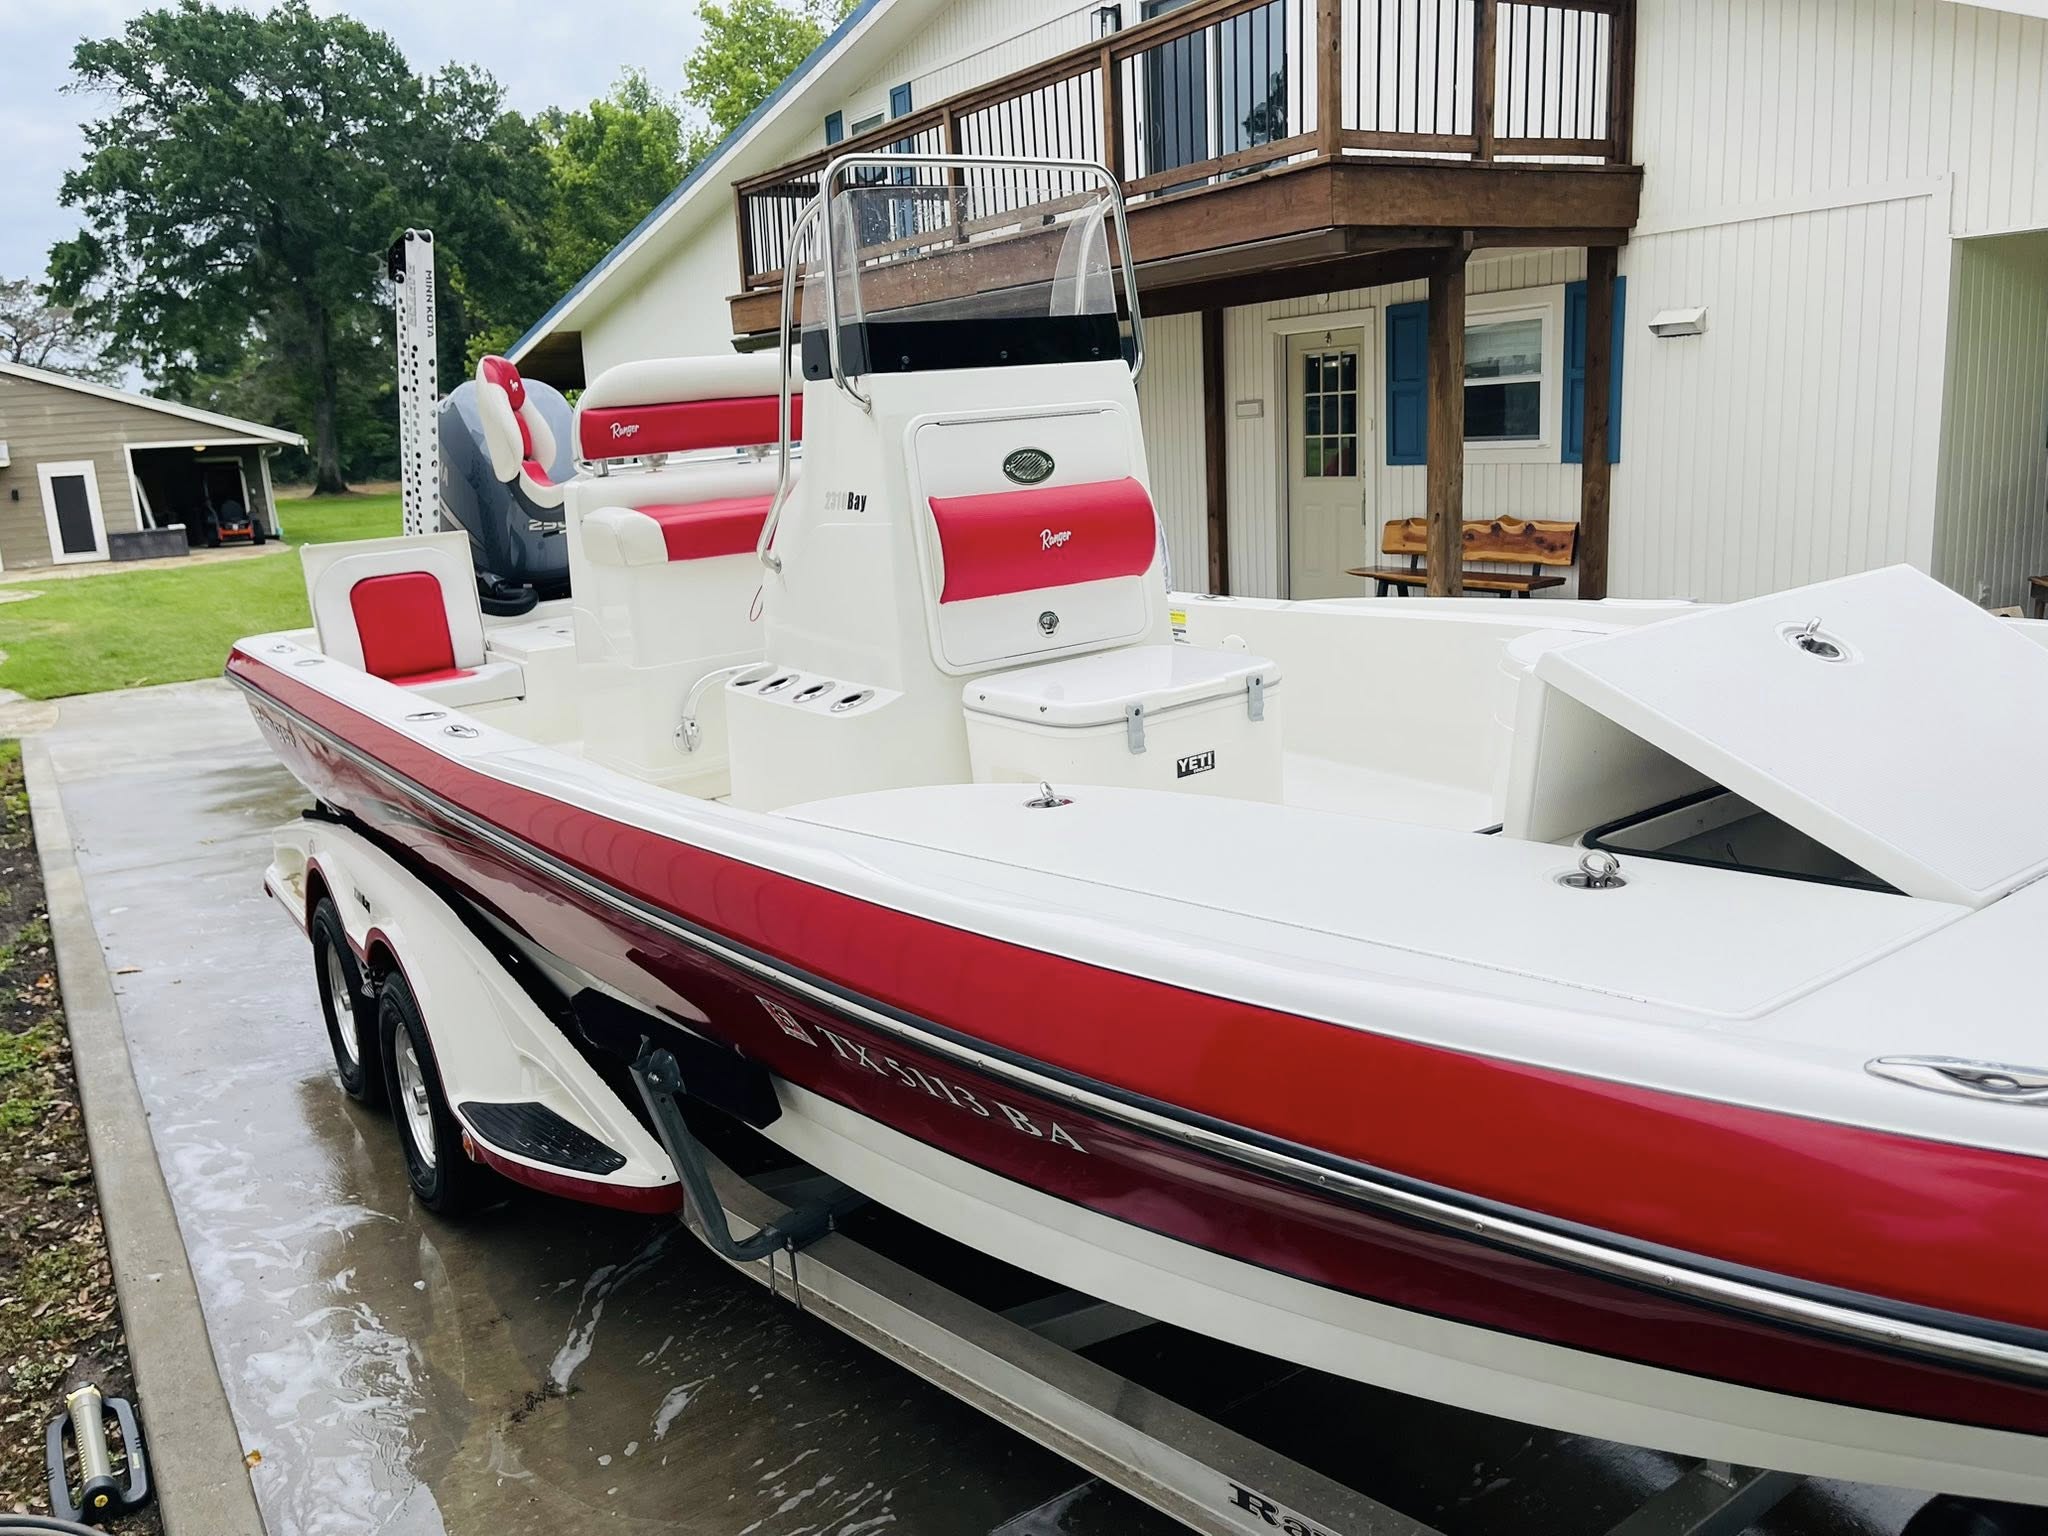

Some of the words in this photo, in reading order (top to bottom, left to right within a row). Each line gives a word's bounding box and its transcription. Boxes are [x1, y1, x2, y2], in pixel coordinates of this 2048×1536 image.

[425, 270, 433, 303] MINN
[426, 306, 435, 338] KOTA
[610, 422, 640, 440] Ranger
[1040, 528, 1071, 551] Ranger
[1178, 751, 1212, 773] YETI
[814, 1024, 889, 1077] TX
[884, 1056, 990, 1117] 5113
[991, 1100, 1090, 1154] BA
[1228, 1482, 1331, 1536] Ra
